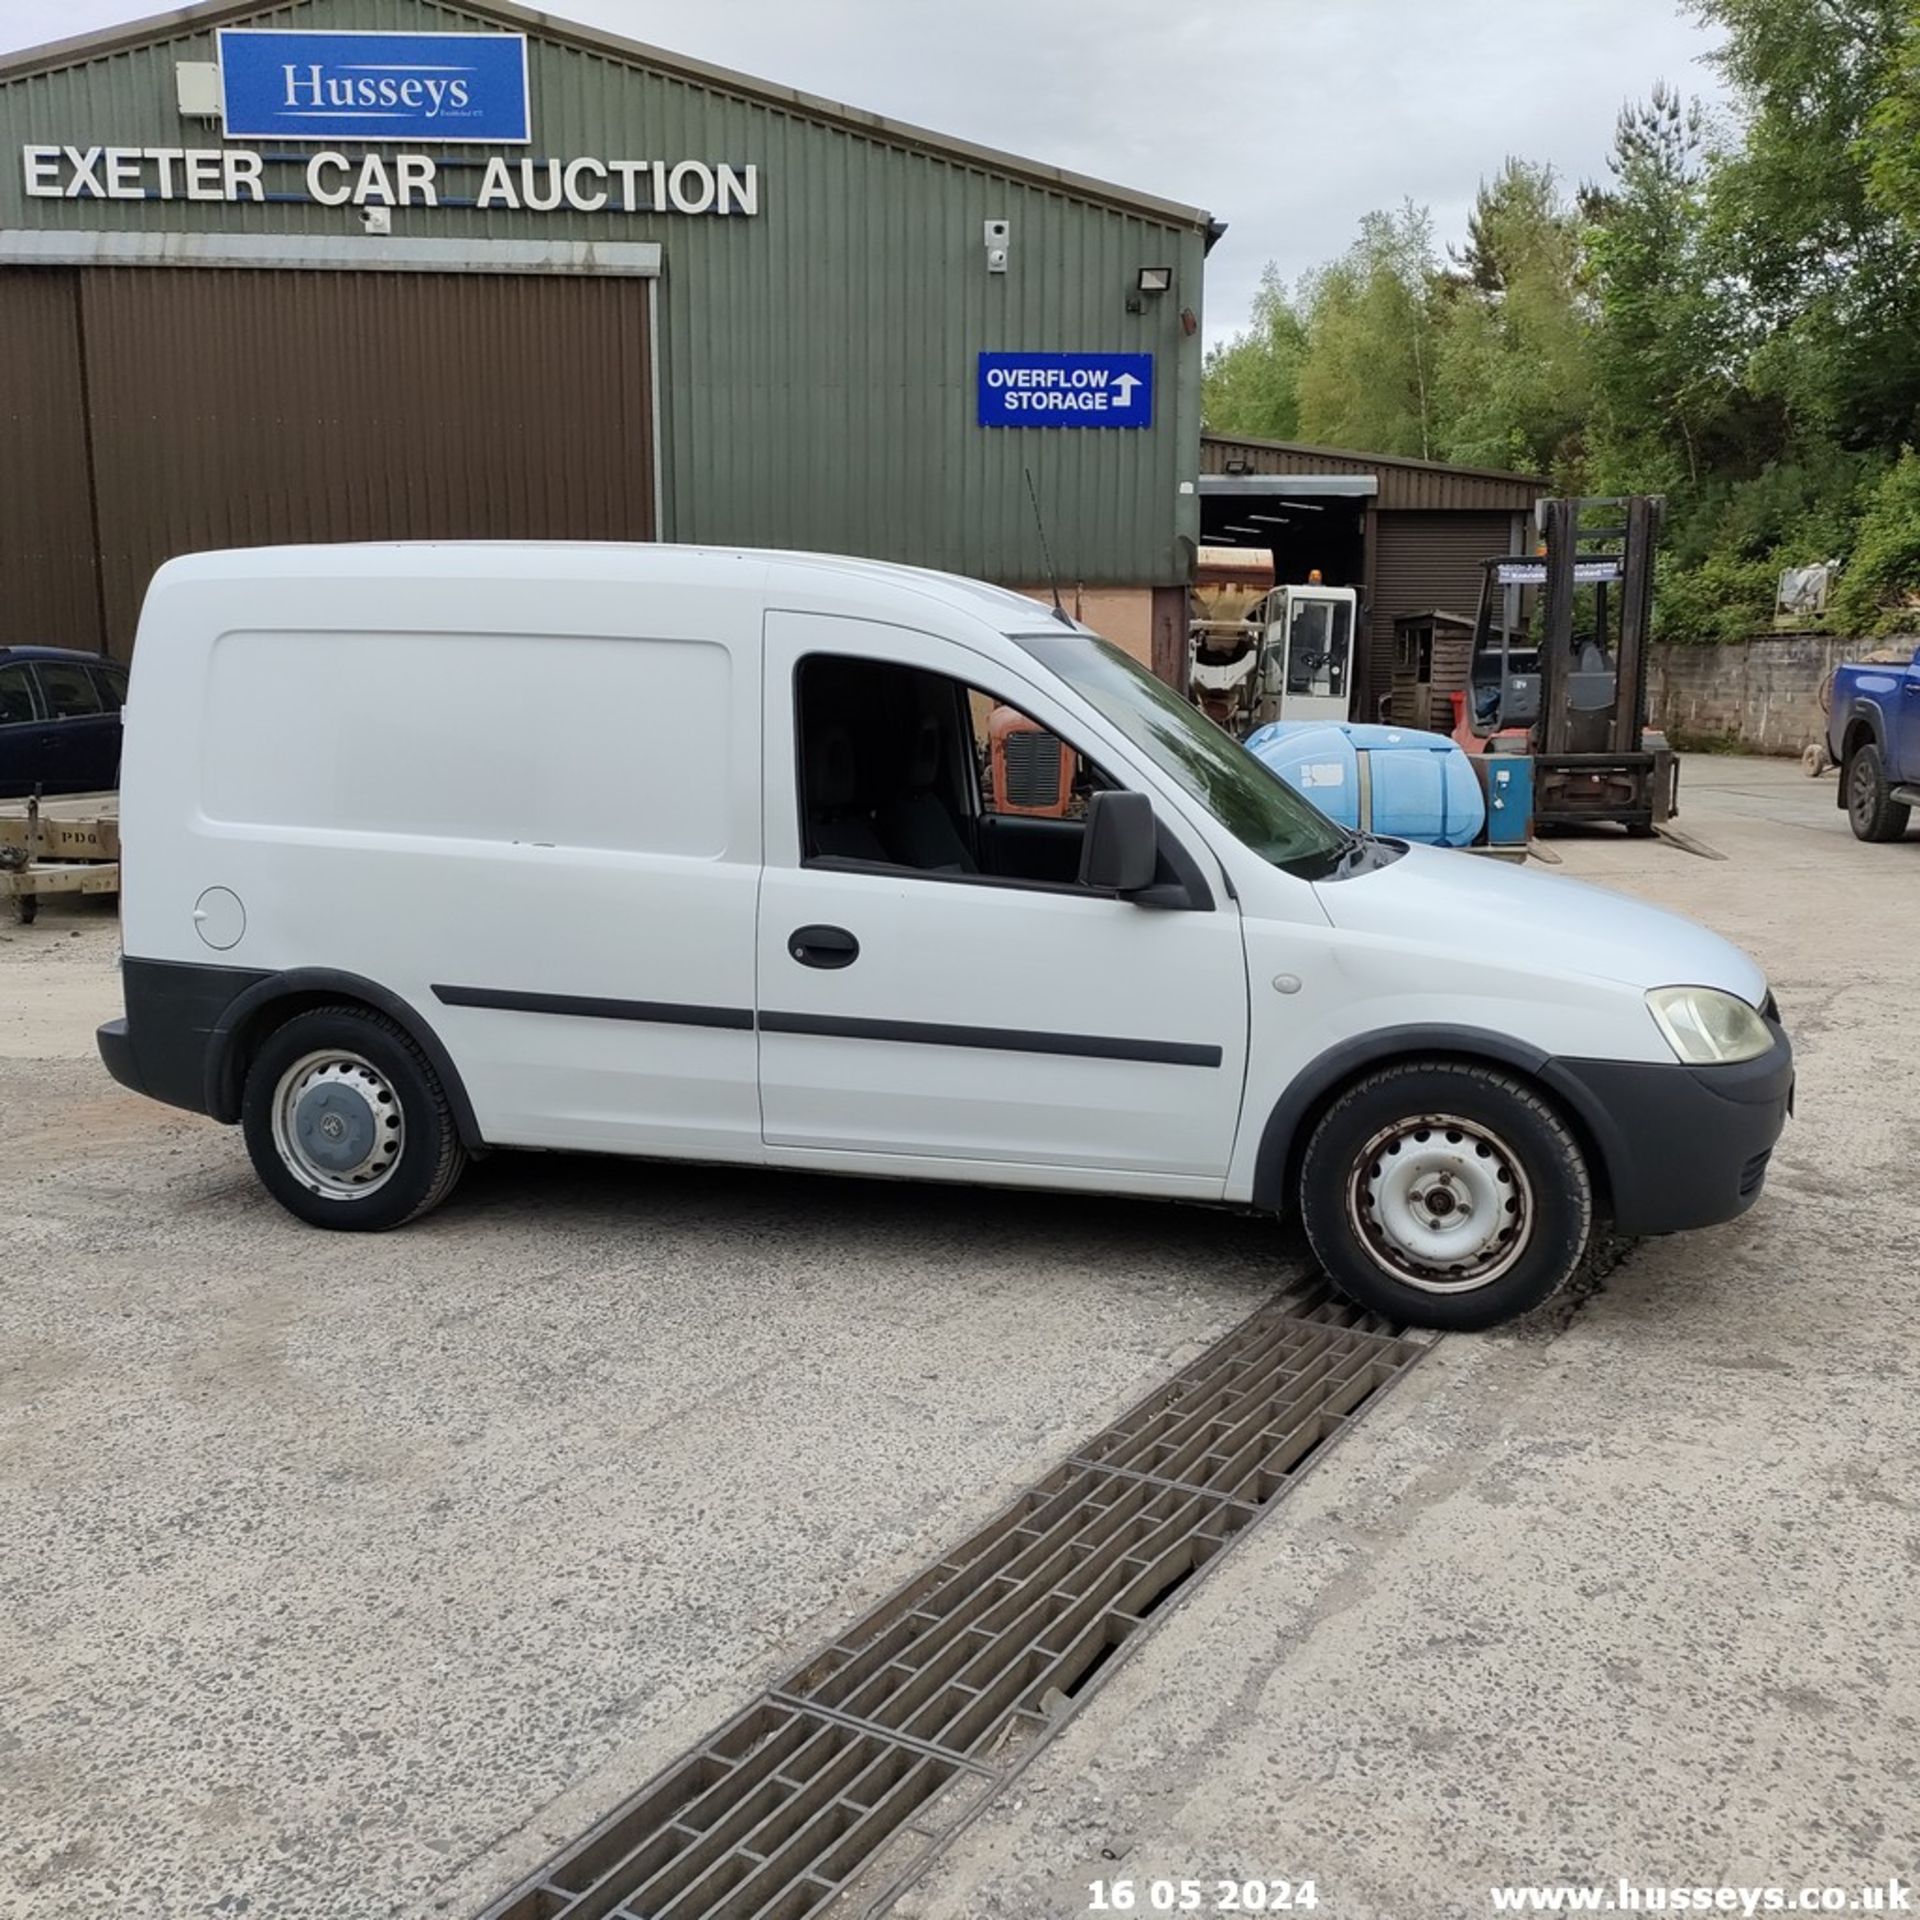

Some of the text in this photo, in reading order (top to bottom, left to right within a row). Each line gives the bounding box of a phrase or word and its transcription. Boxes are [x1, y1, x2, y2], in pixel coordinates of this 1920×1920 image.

[281, 63, 469, 118] Husseys
[23, 144, 759, 216] EXETER CAR AUCTION
[986, 368, 1109, 388] OVERFLOW
[1004, 391, 1108, 410] STORAGE
